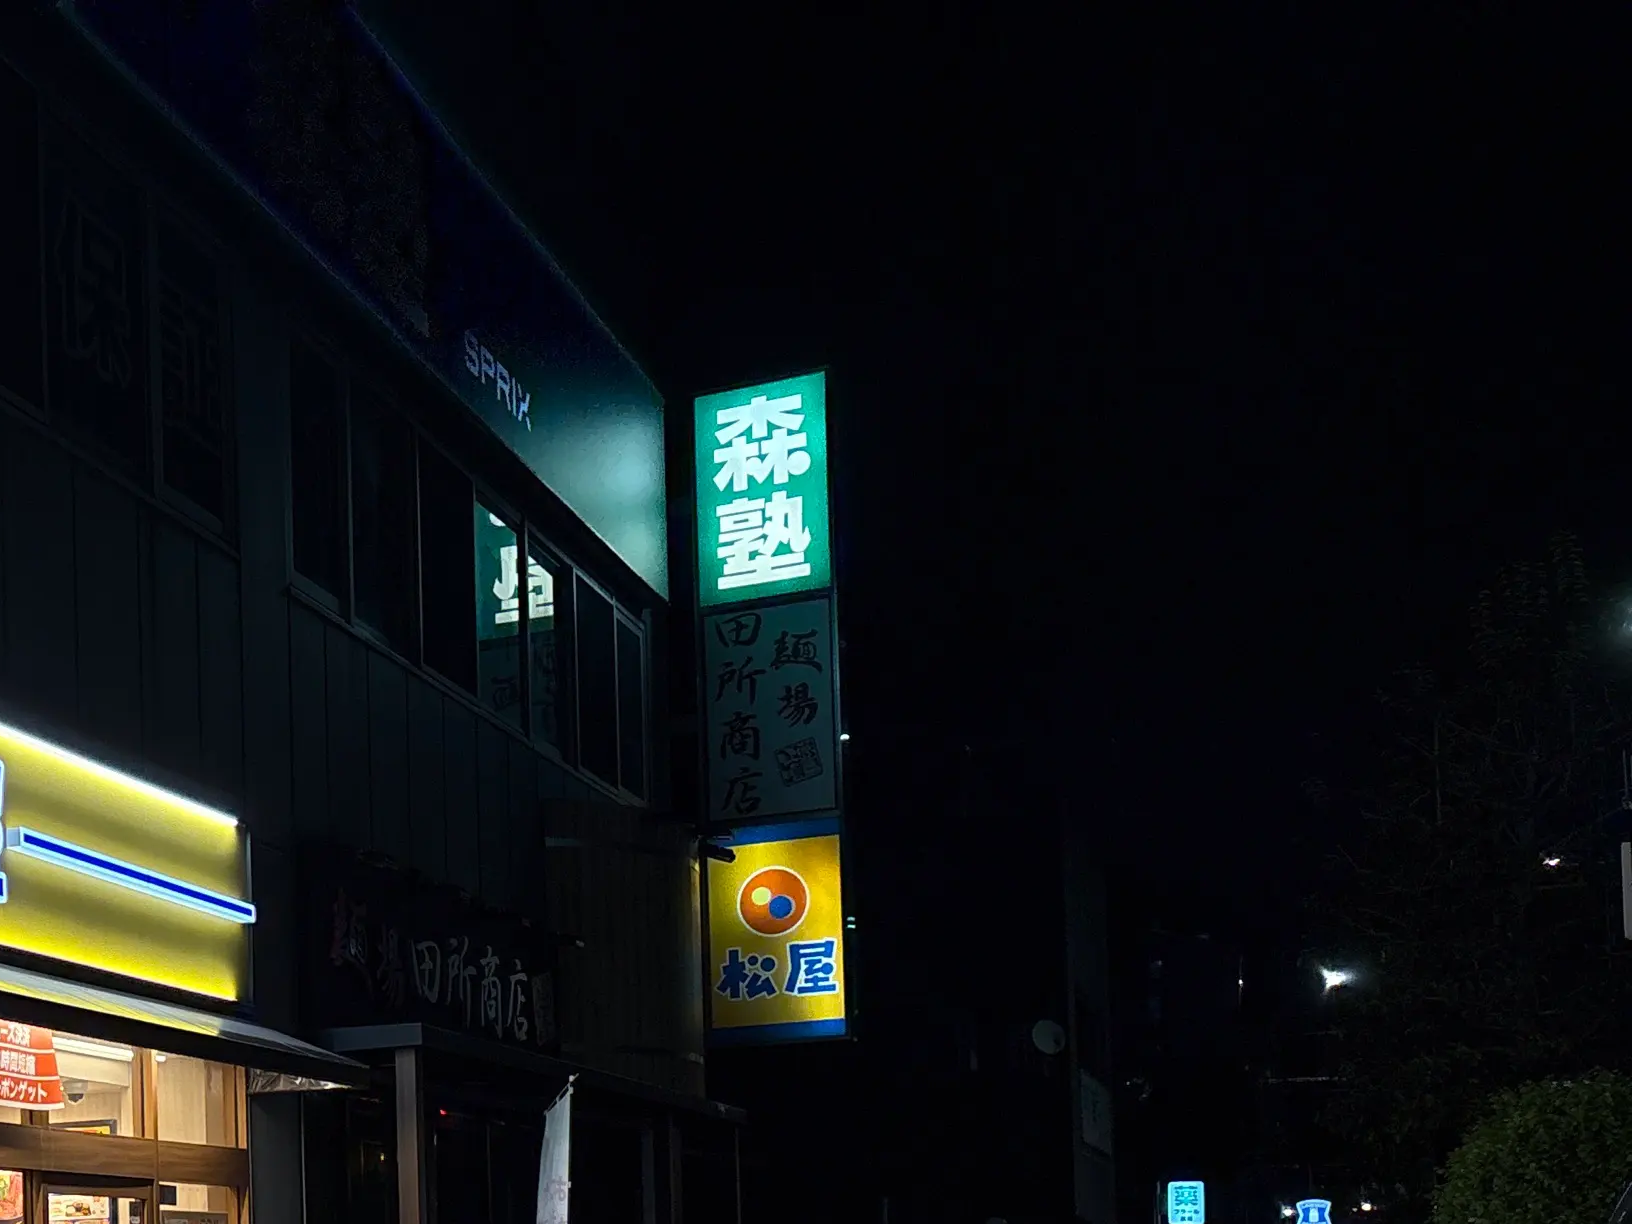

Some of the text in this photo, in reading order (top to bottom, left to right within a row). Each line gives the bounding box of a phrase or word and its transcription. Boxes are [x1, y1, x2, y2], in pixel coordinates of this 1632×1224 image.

[464, 329, 532, 432] SPRIX
[712, 393, 812, 590] 森塾
[713, 611, 767, 814] 田所商店
[715, 938, 839, 1001] 松屋
